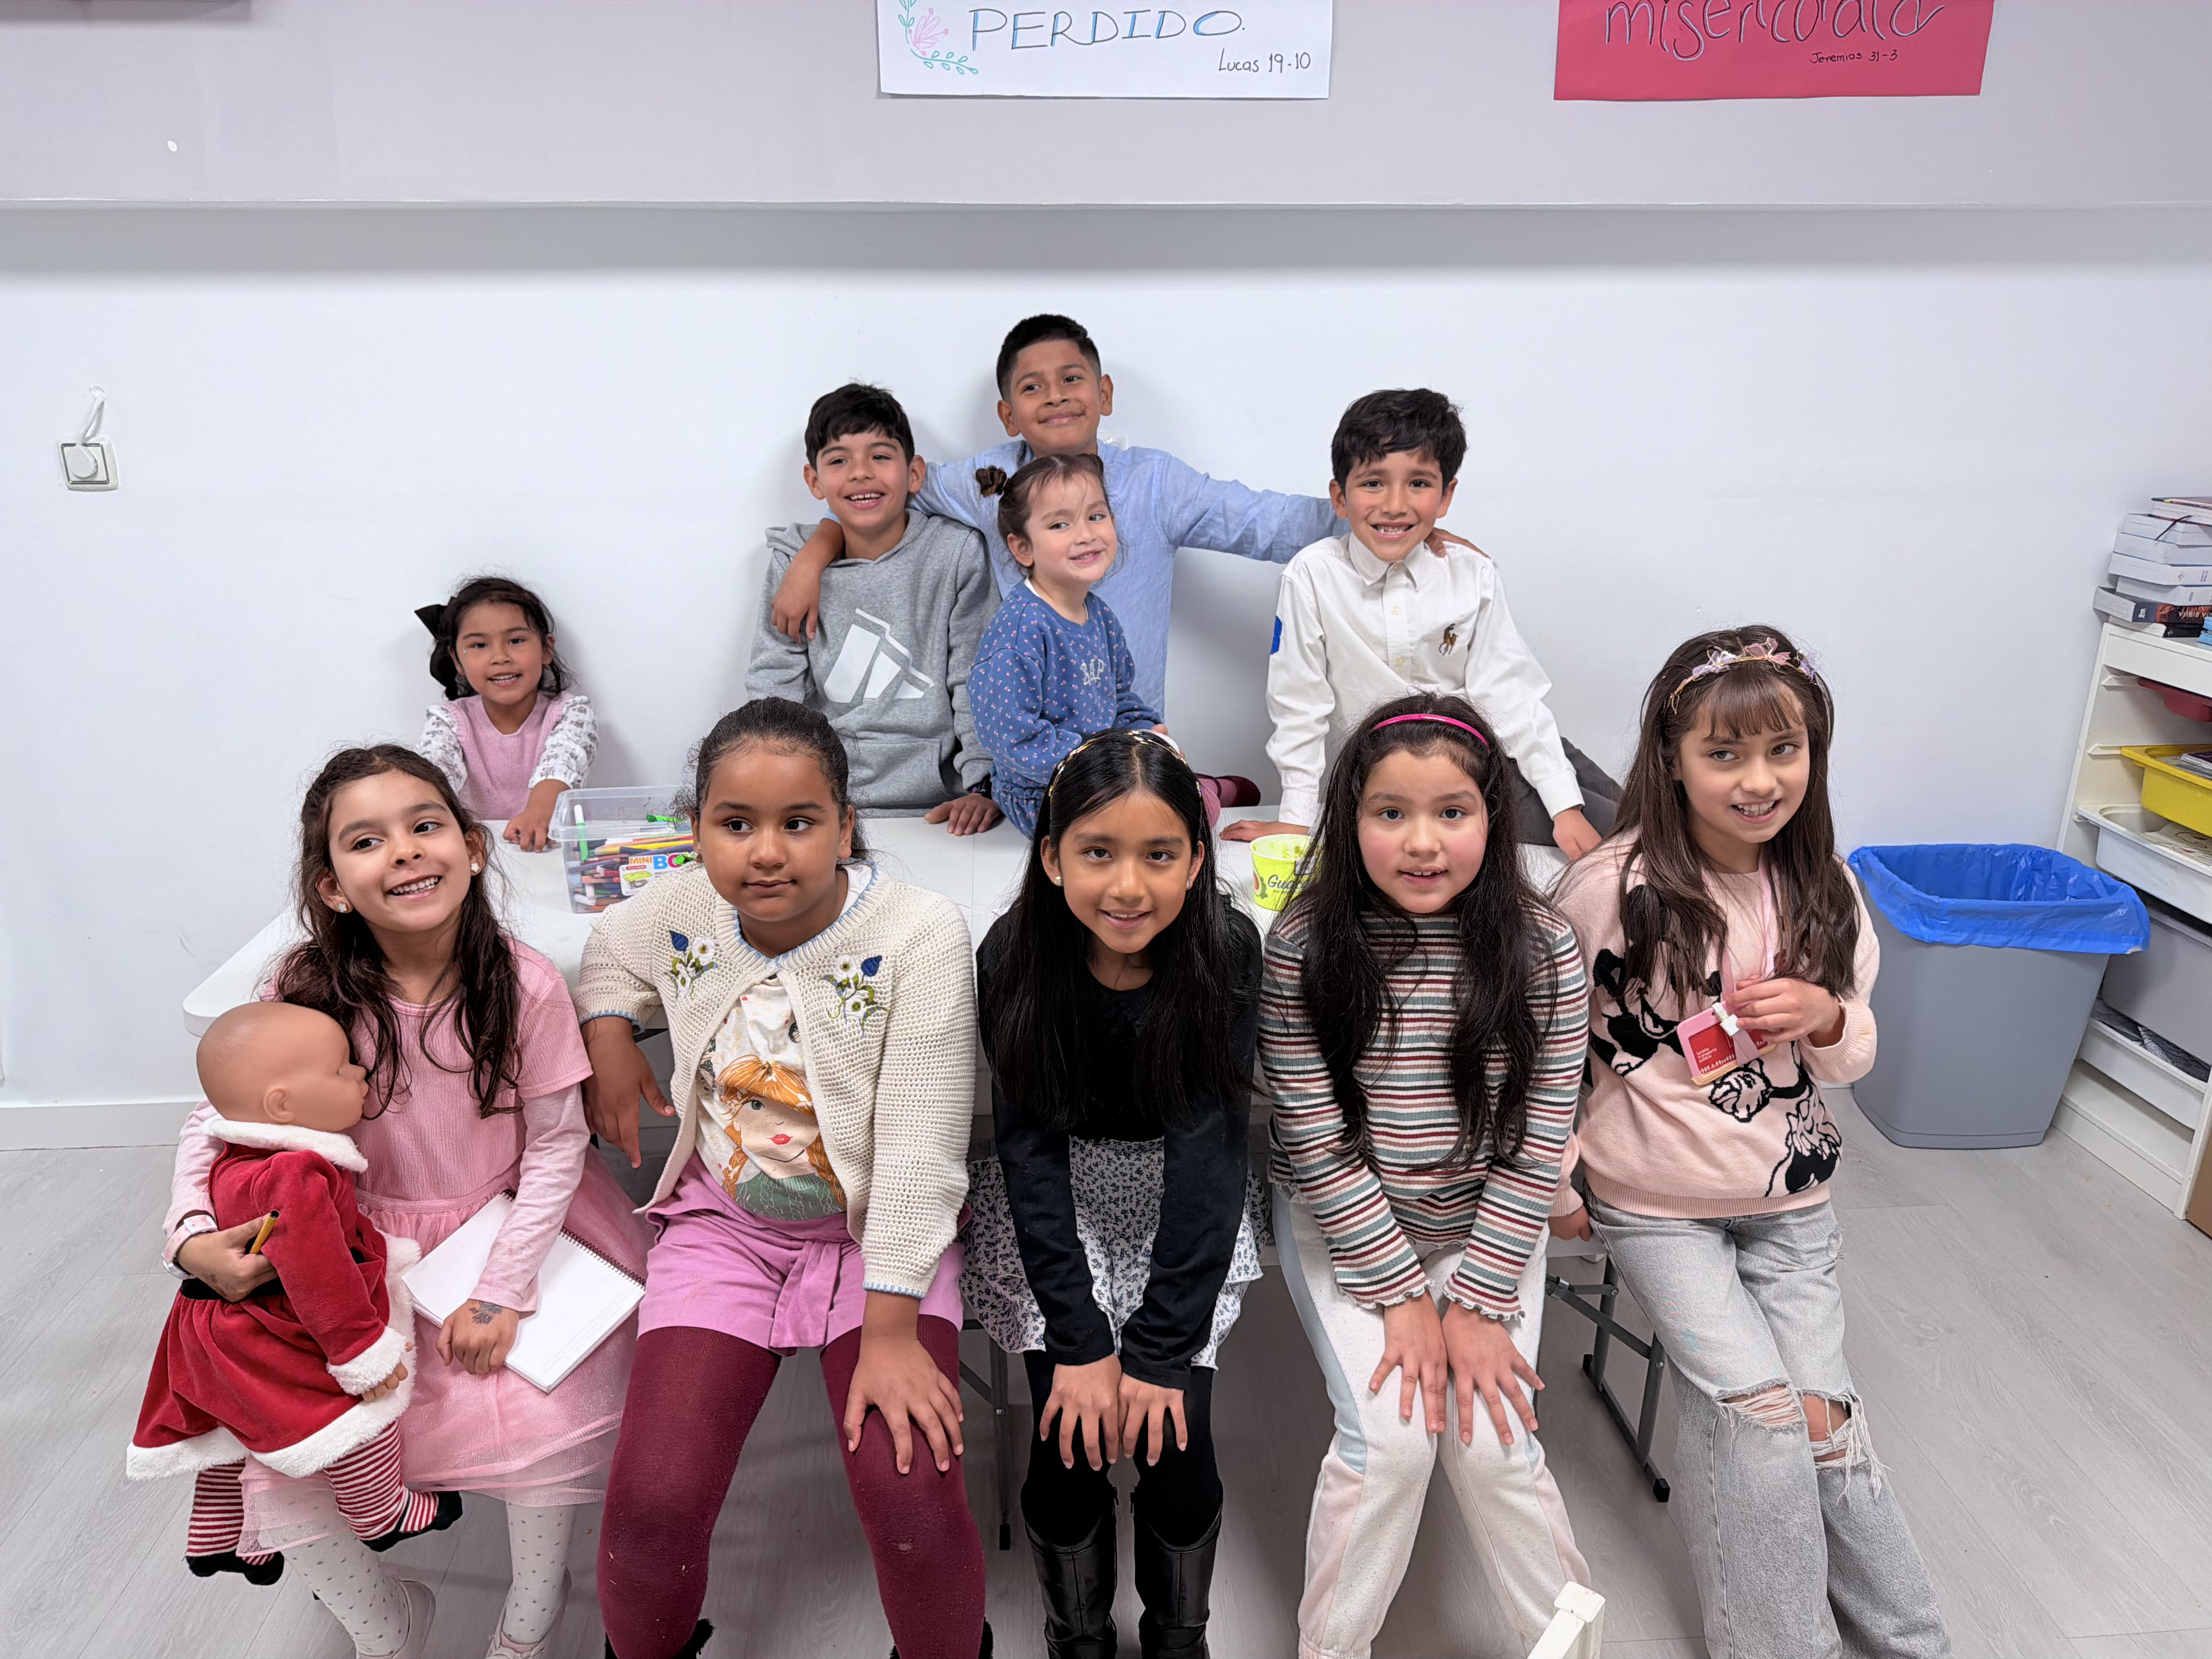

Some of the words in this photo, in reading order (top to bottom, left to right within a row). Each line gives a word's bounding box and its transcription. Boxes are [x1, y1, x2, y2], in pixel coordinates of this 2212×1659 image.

[969, 8, 1245, 50] PERDIDO.
[1218, 47, 1260, 73] Lucas
[1268, 52, 1311, 74] 19-10
[630, 856, 652, 865] MINI
